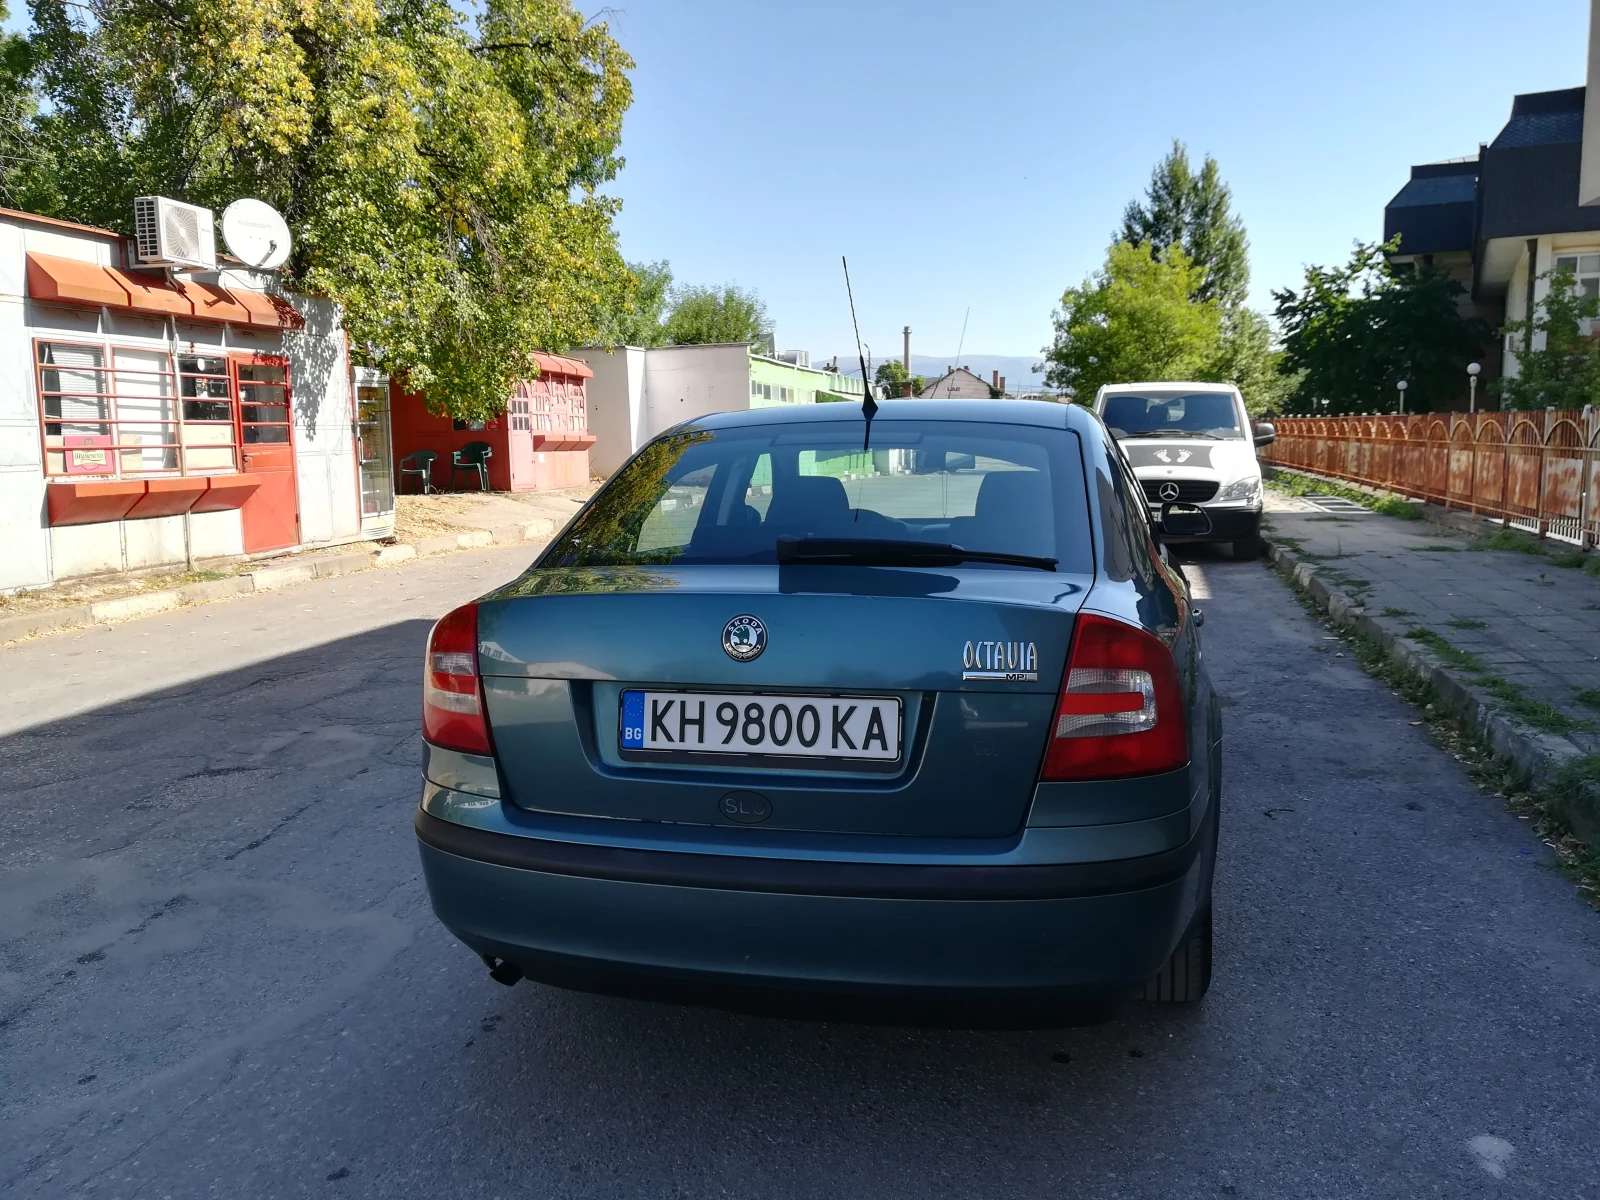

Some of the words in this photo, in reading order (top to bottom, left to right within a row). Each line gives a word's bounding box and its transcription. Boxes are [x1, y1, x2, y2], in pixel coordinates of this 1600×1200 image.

[963, 640, 1038, 670] OCTAVIA
[624, 727, 642, 741] BG
[650, 699, 705, 744] KH
[715, 701, 821, 748] 9800
[831, 705, 889, 751] KA
